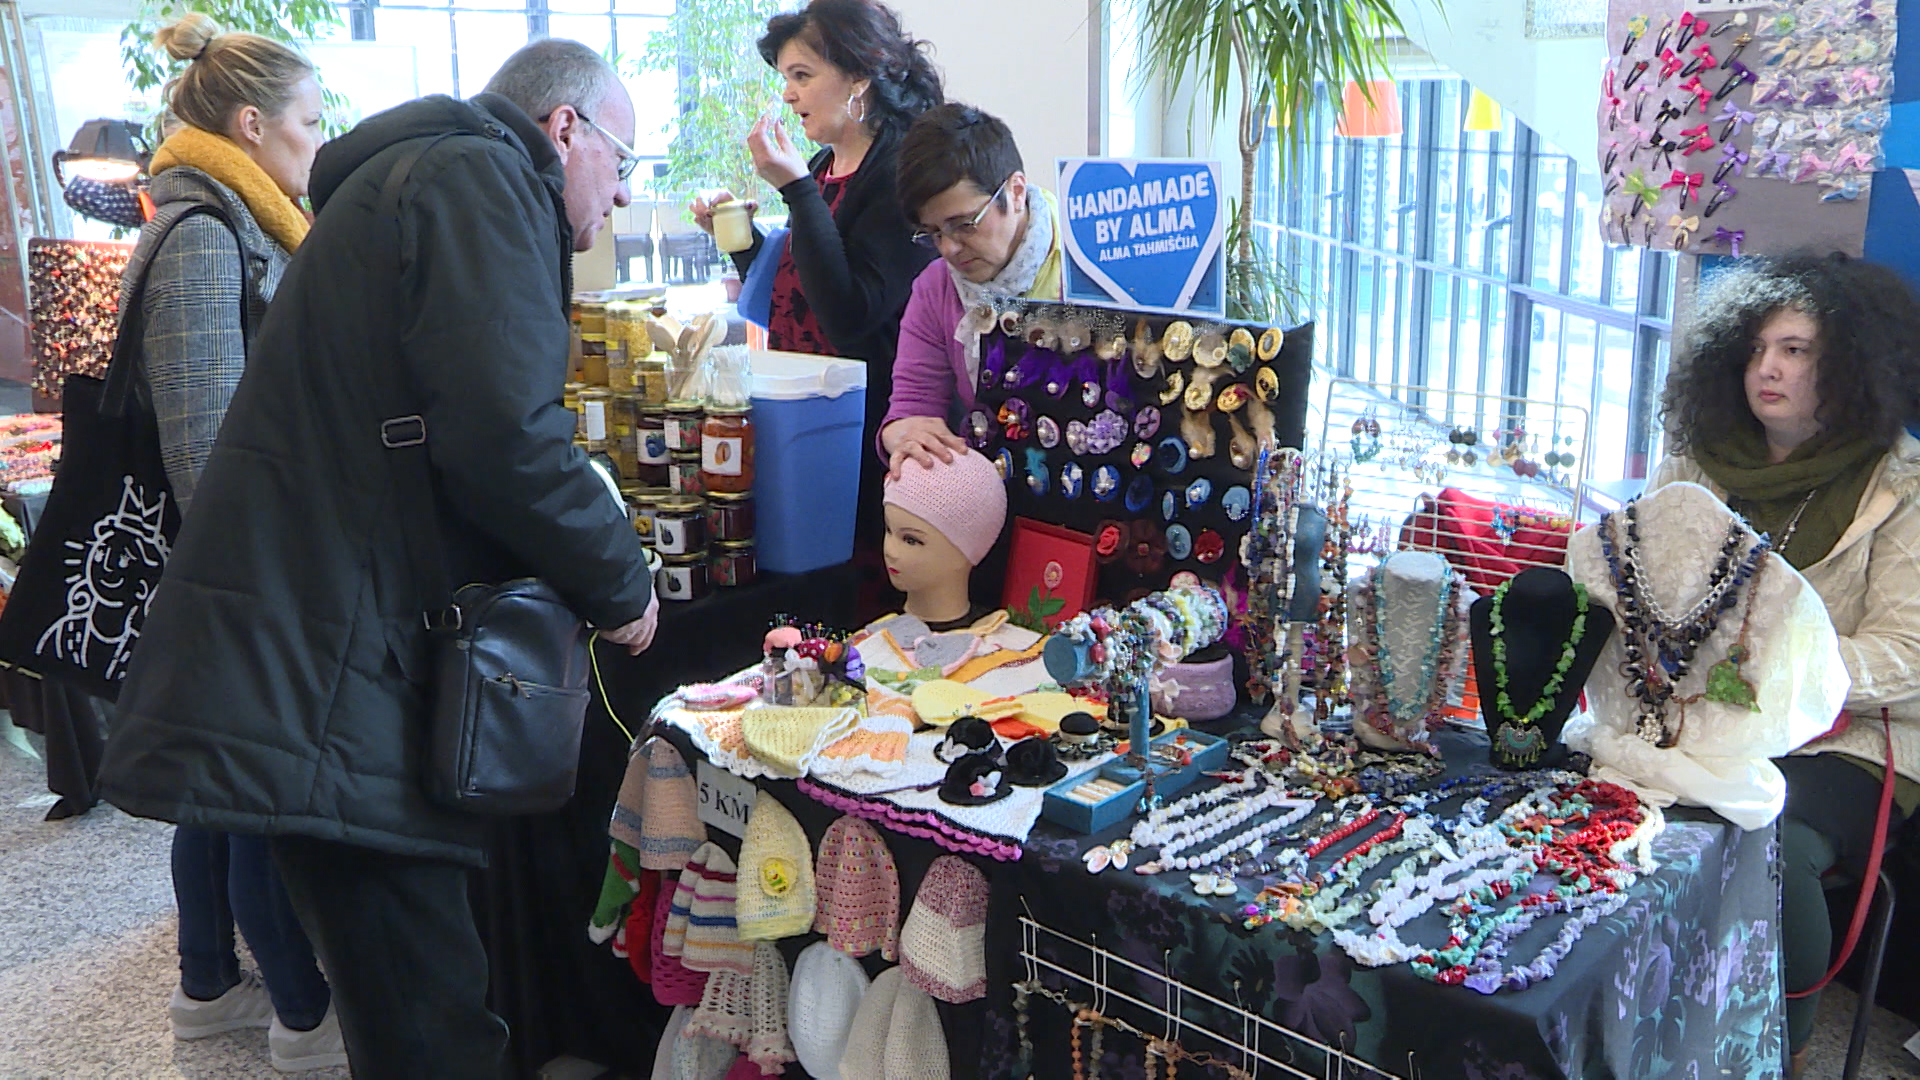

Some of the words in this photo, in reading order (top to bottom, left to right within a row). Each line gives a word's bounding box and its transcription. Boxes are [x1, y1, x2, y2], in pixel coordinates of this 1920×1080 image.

[1069, 171, 1210, 220] HANDAMADE
[1096, 217, 1122, 244] BY
[1129, 205, 1196, 239] ALMA
[1099, 245, 1131, 262] ALMA
[700, 782, 709, 804] 5
[715, 789, 749, 825] KM
